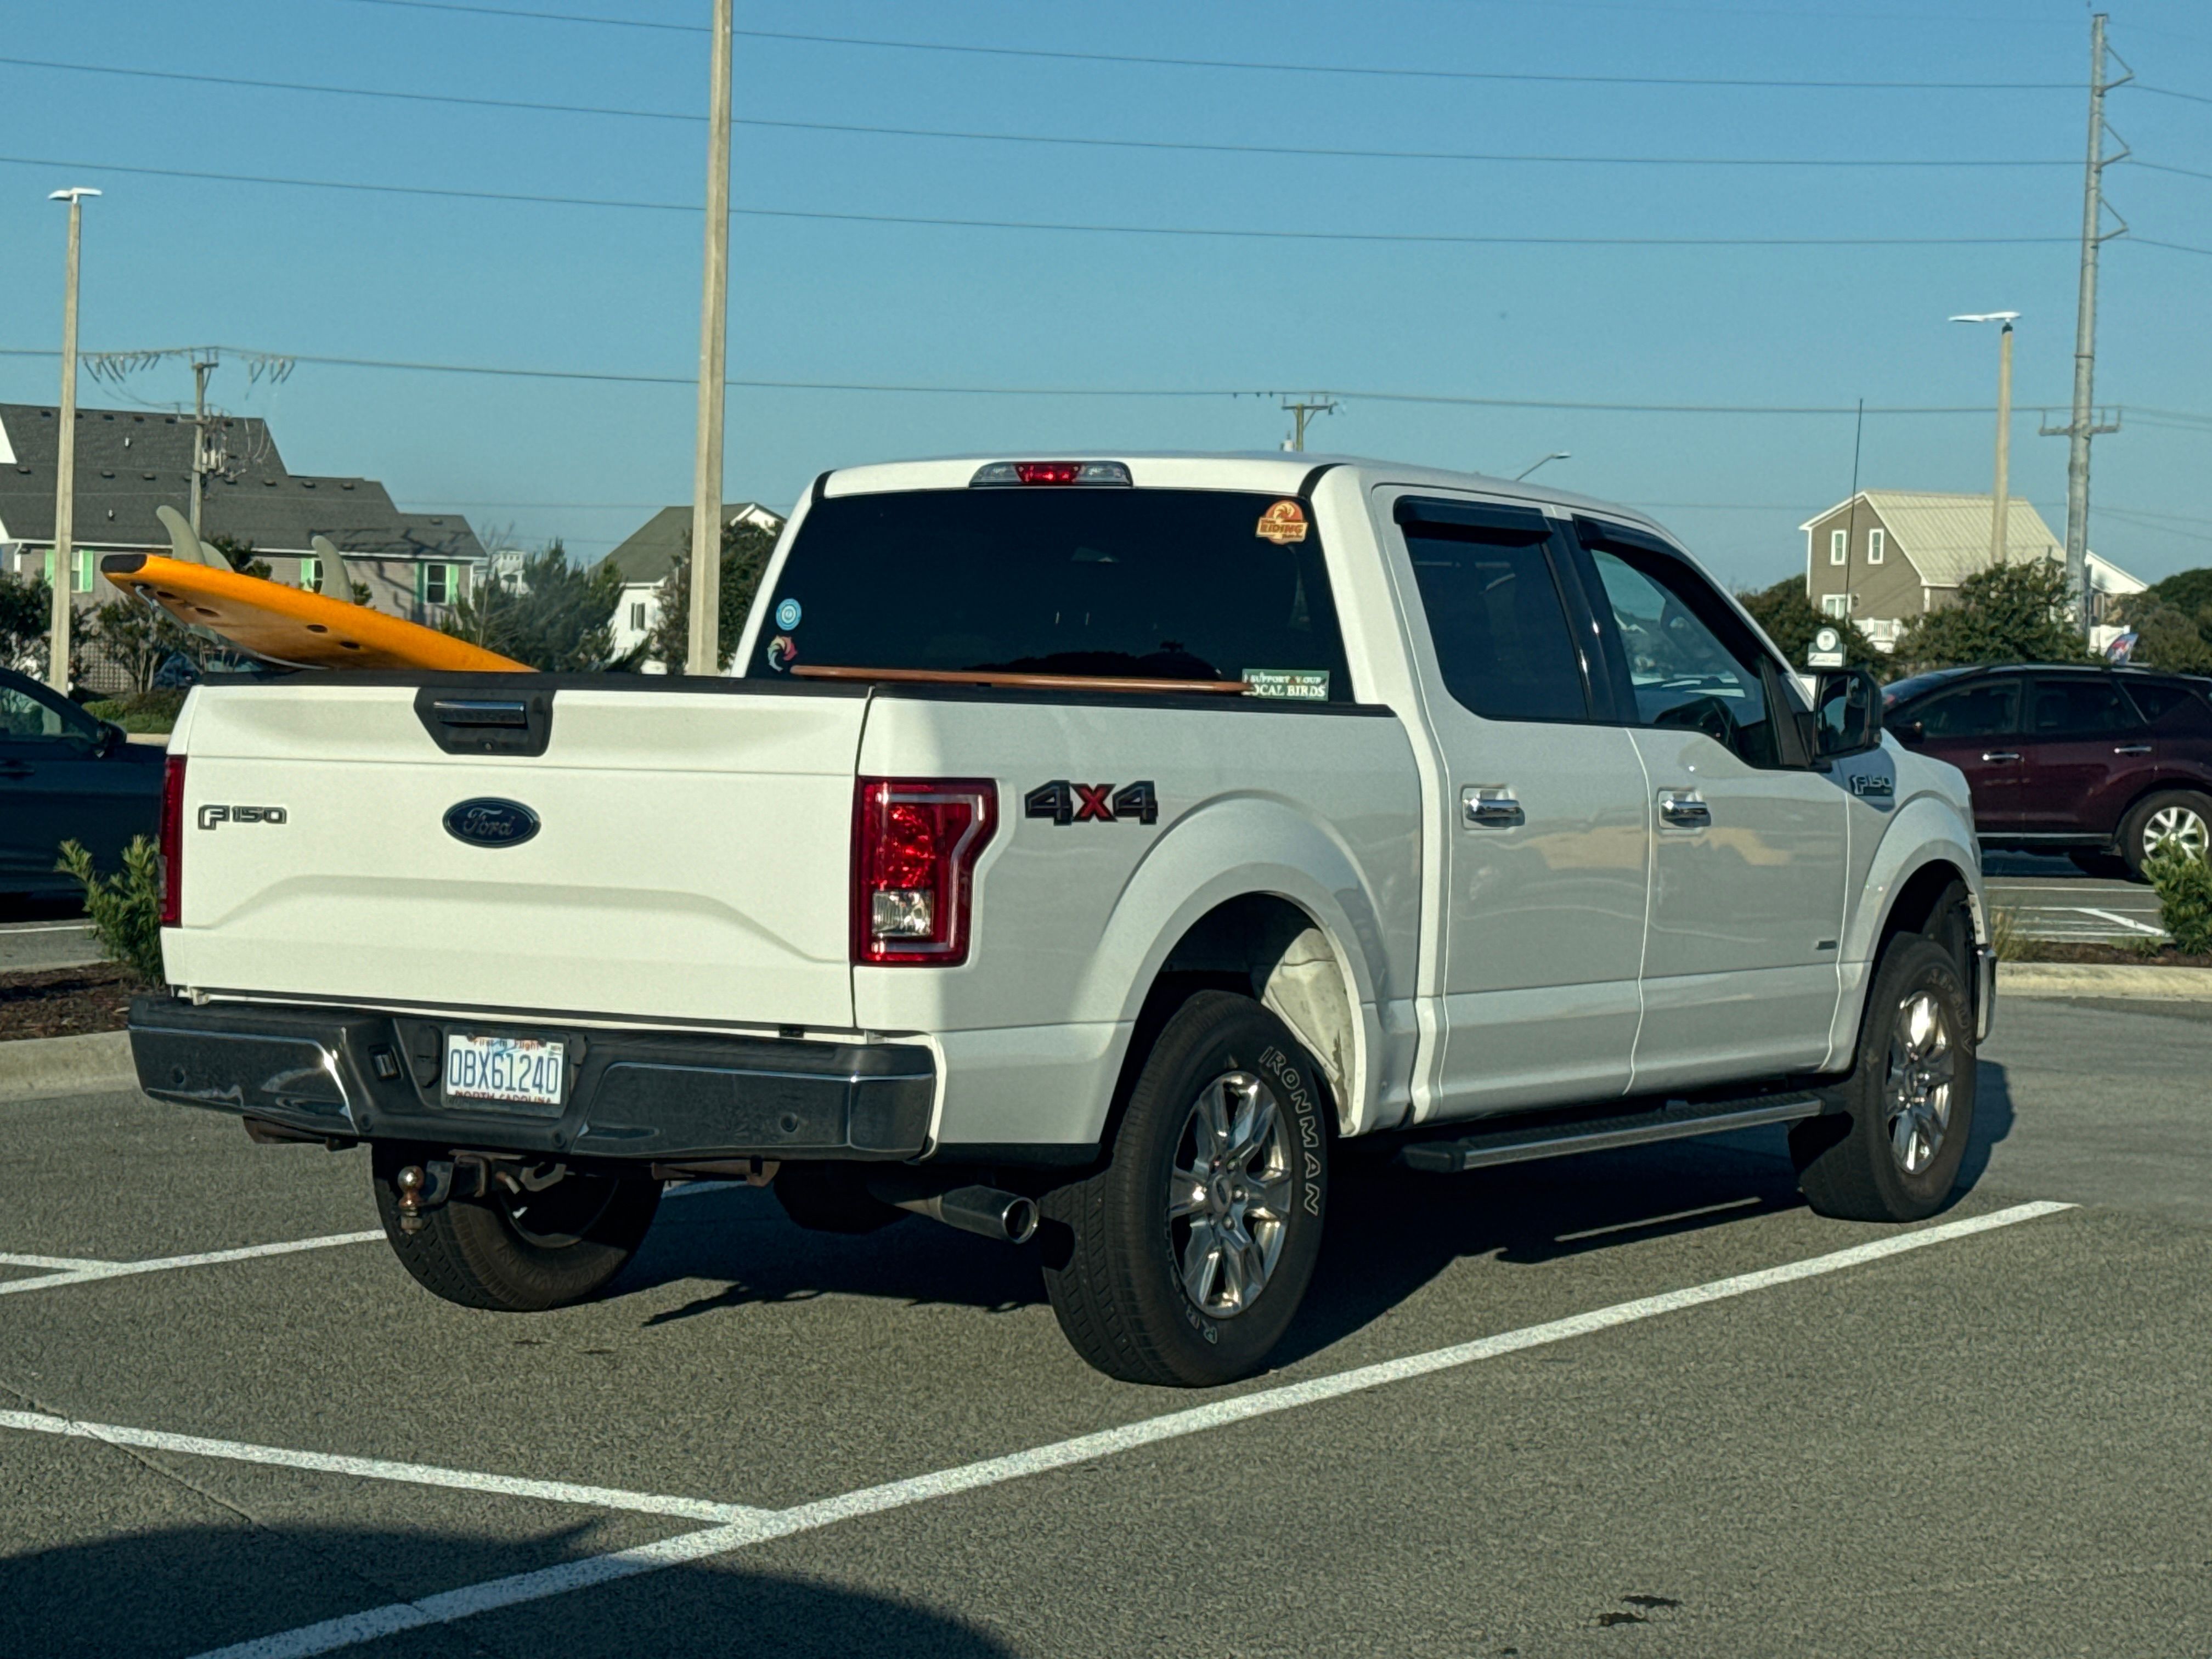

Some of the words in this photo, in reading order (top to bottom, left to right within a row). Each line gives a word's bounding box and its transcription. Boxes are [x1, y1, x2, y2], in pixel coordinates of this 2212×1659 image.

[1250, 675, 1291, 683] SUPPORT
[1295, 676, 1322, 684] YOUR
[1286, 685, 1325, 697] BIRDS
[464, 808, 516, 836] Ford
[1258, 1046, 1321, 1216] IRONMAN
